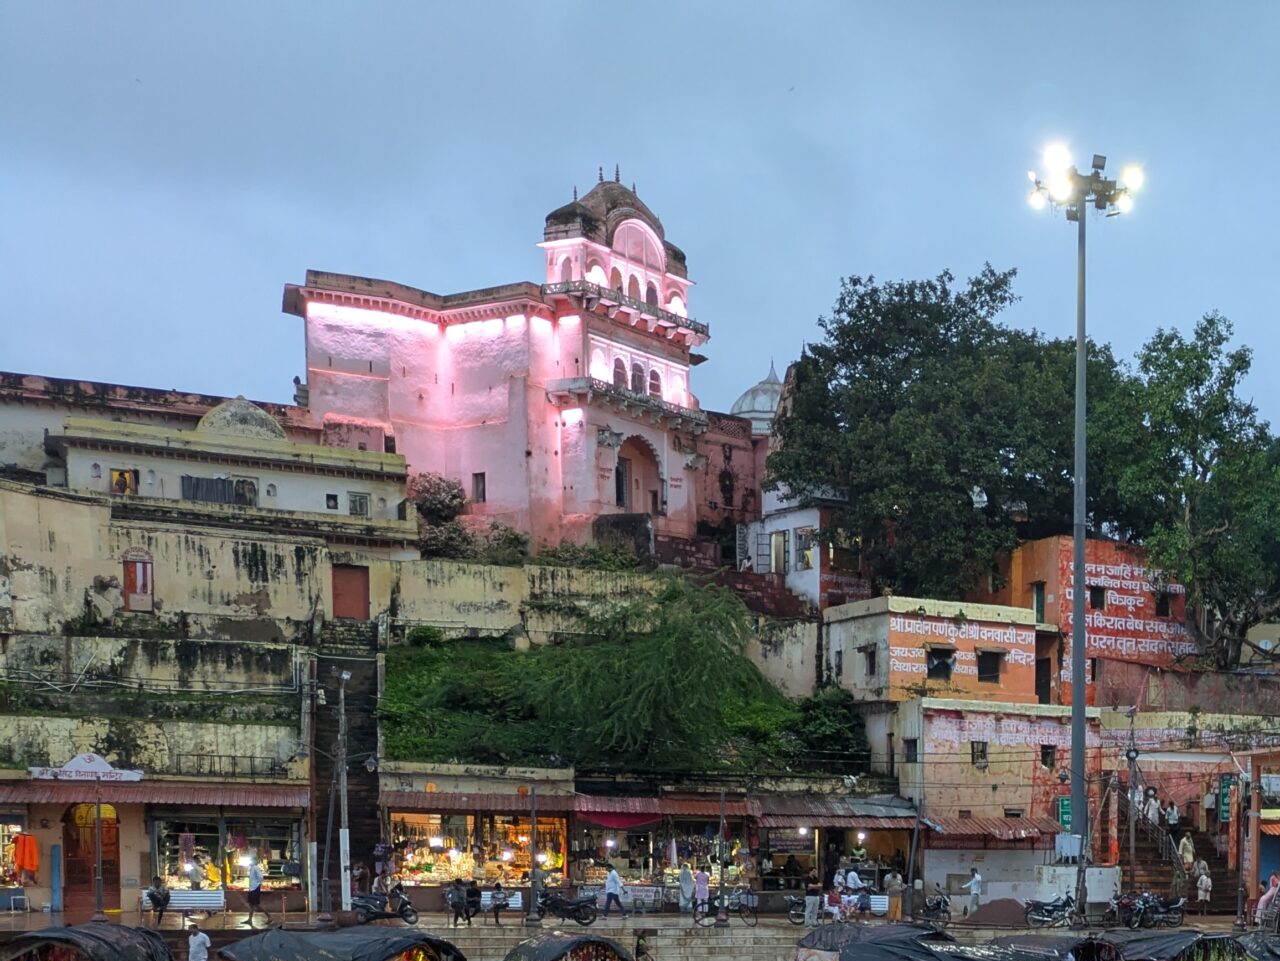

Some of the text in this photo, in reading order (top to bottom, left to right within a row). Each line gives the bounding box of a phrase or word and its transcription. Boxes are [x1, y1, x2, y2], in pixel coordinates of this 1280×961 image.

[1107, 590, 1146, 612] चित्रकूट
[889, 615, 904, 633] श्री
[1093, 611, 1125, 630] किरात
